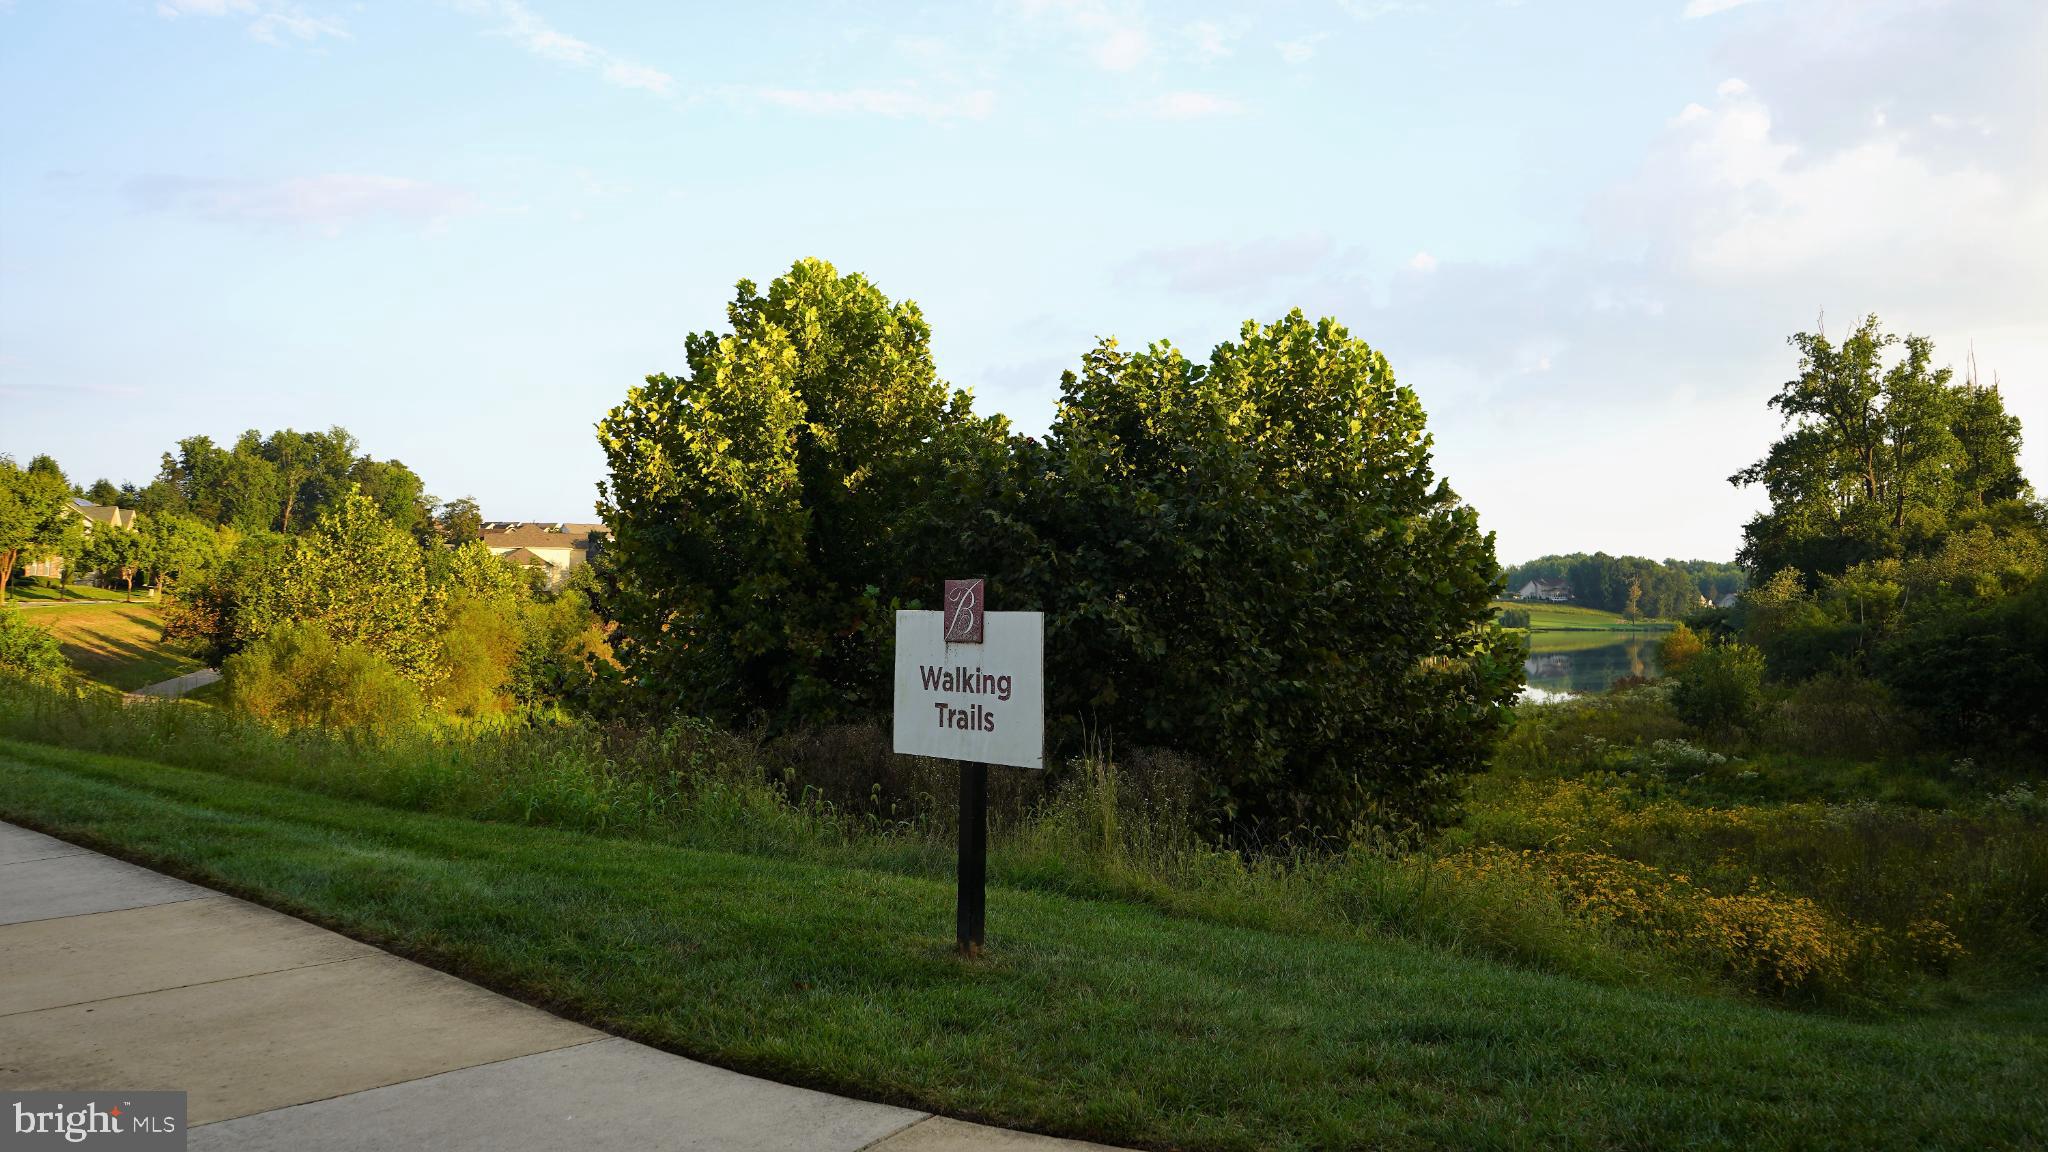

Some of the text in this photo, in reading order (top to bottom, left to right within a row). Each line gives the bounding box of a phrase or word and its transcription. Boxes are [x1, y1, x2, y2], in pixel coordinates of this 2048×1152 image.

[944, 579, 983, 640] B
[920, 665, 1012, 701] Walking
[935, 703, 995, 732] Trails
